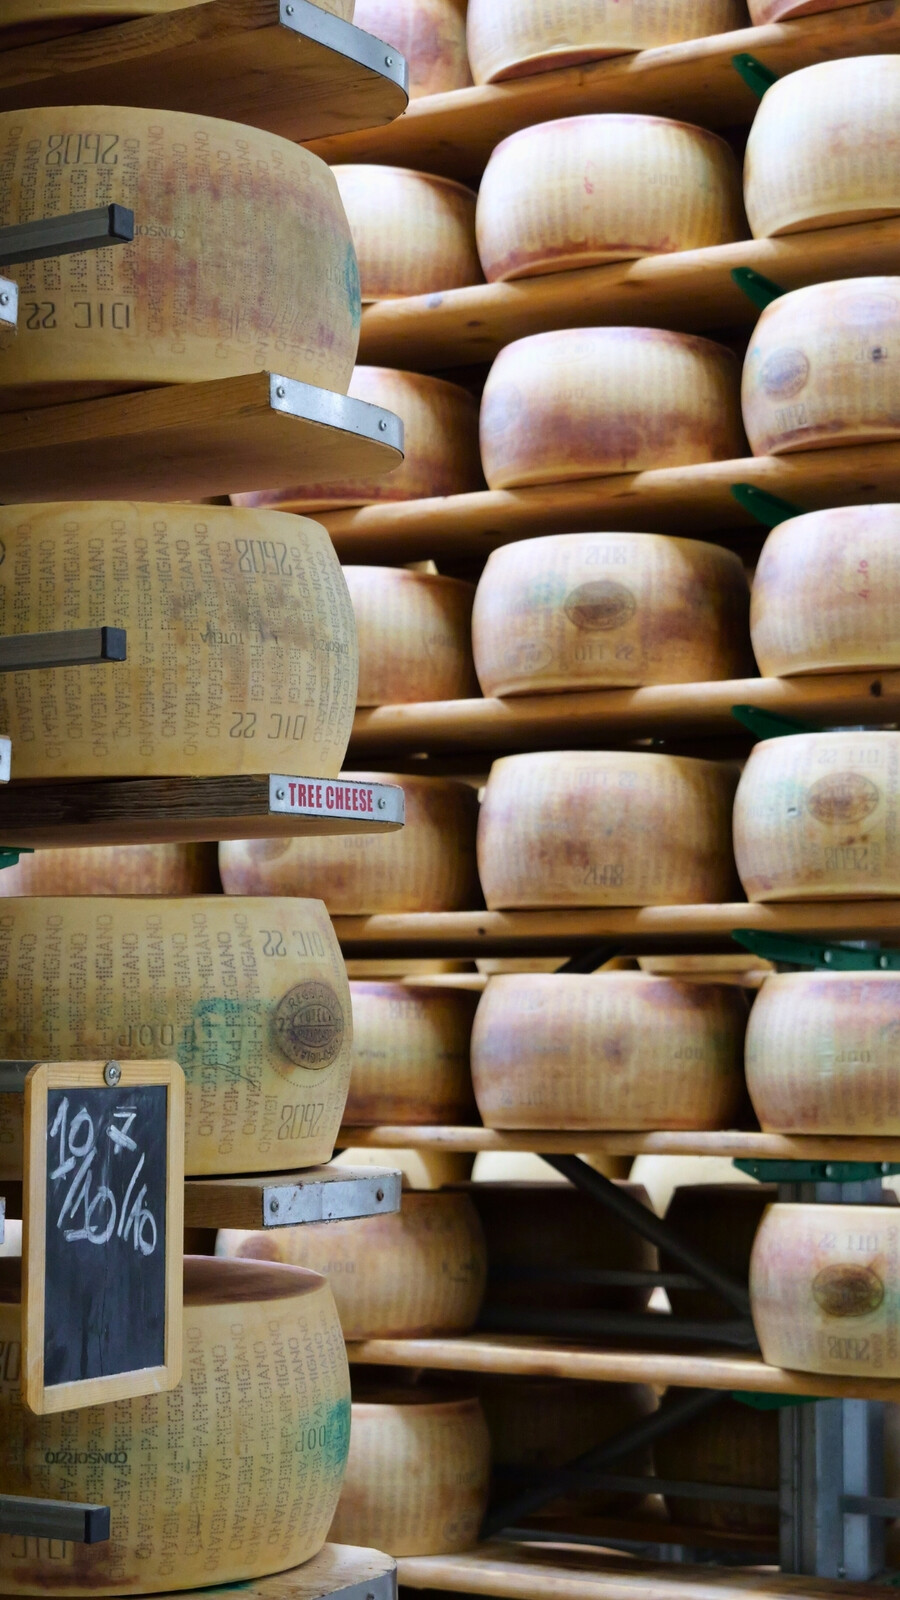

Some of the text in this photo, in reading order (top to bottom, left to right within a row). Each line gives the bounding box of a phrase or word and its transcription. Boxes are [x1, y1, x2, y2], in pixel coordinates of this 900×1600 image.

[45, 133, 119, 166] 2608
[25, 301, 131, 331] DIC 22
[235, 538, 293, 576] 2608
[229, 711, 307, 740] DIC 22
[288, 783, 373, 812] TREE CHEESE
[259, 930, 326, 958] DIC 22
[118, 1024, 174, 1048] DOP
[294, 1424, 327, 1452] DOP
[45, 1451, 128, 1466] CONSORZIO
